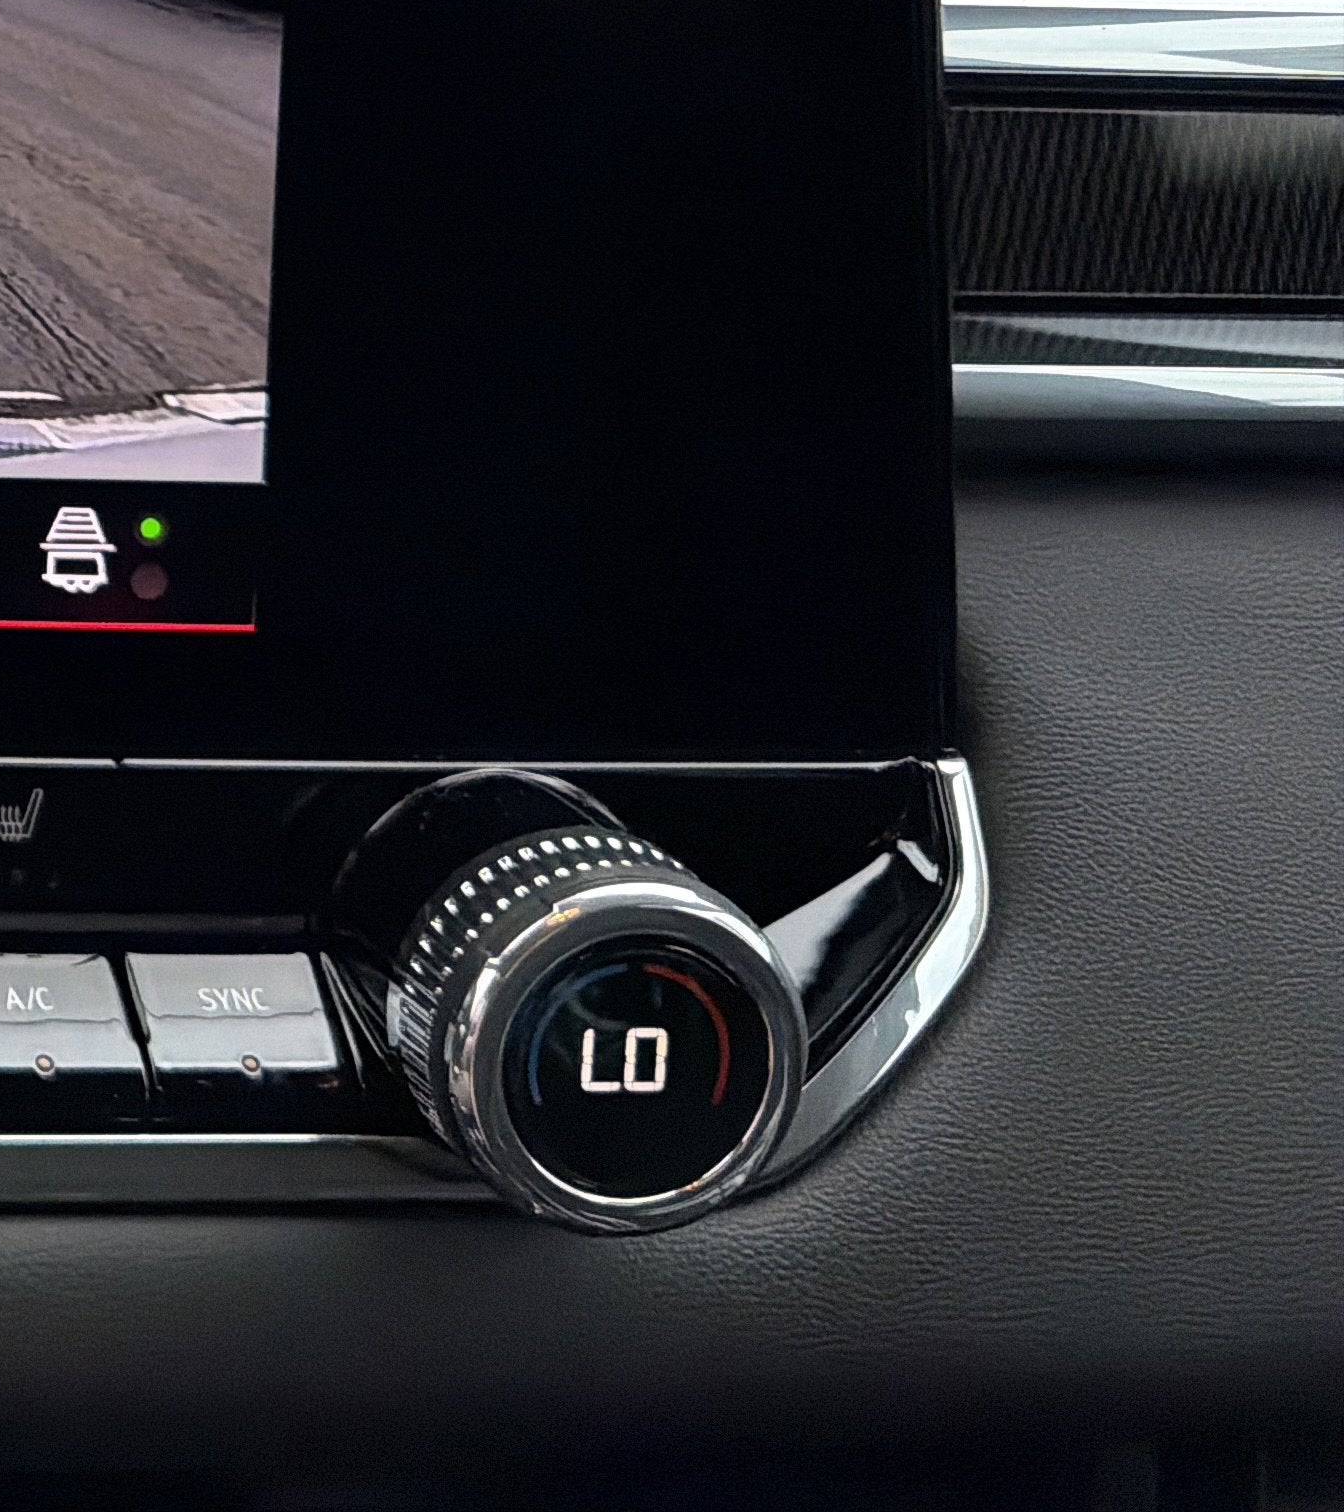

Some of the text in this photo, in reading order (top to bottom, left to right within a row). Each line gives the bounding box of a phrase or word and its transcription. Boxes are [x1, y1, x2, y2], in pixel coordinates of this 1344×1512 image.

[5, 986, 55, 1011] A/C
[197, 987, 270, 1012] SYNC
[580, 1025, 670, 1094] LO
